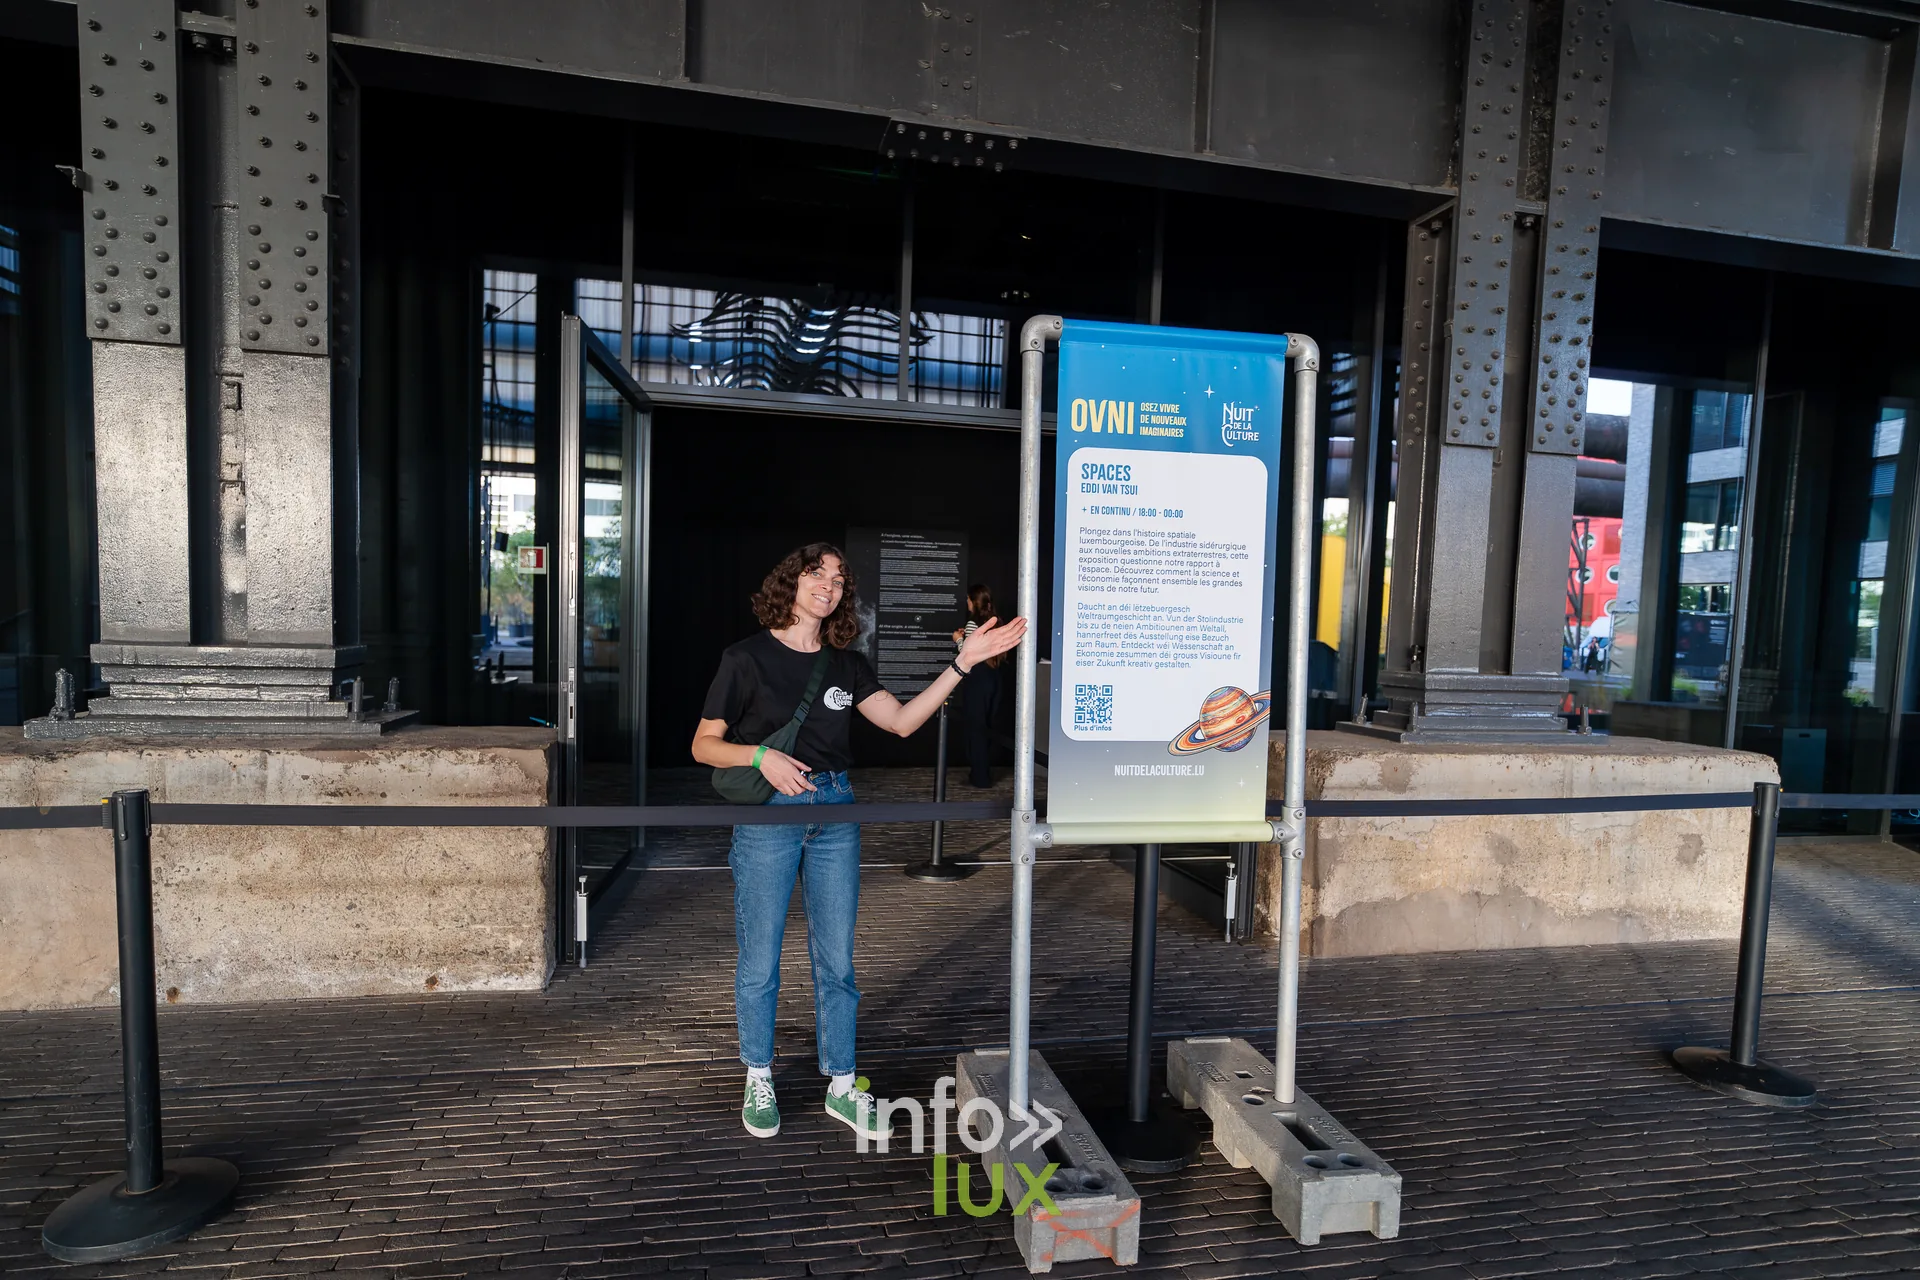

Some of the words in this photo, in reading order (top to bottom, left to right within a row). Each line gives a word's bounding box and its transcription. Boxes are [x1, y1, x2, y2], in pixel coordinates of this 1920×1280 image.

[1140, 402, 1158, 412] OSEZ
[1159, 403, 1180, 414] VIVRE
[1222, 401, 1254, 426] NUIT
[1070, 398, 1135, 435] OVNI
[1140, 414, 1150, 424] DE
[1150, 415, 1187, 426] NOUVEAUX
[1139, 426, 1184, 438] IMAGINAIRES
[1233, 422, 1242, 430] DE
[1221, 424, 1260, 447] CULTURE
[1081, 463, 1131, 482] SPACES
[1081, 483, 1100, 494] EDDI
[1101, 484, 1118, 495] VAN
[1120, 485, 1138, 496] TSUI
[1090, 506, 1100, 515] EN
[1101, 506, 1131, 516] CONTINU
[1138, 508, 1157, 517] 18:00
[1163, 509, 1184, 519] 00:00
[1079, 527, 1111, 537] Plongez
[1112, 528, 1132, 537] dans
[1133, 529, 1166, 538] l'histoire
[1167, 530, 1196, 540] spatiale
[1079, 537, 1147, 548] luxembourgeoise.
[1161, 540, 1198, 549] l'industrie
[1199, 541, 1247, 551] sidérurgique
[1095, 546, 1132, 556] nouvelles
[1133, 548, 1171, 557] ambitions
[1172, 550, 1229, 560] extraterrestres,
[1230, 552, 1249, 560] cette
[1078, 556, 1118, 565] exposition
[1120, 557, 1163, 567] questionne
[1164, 559, 1185, 567] notre
[1186, 560, 1214, 568] rapport
[1215, 559, 1220, 568] à
[1078, 565, 1112, 575] l'espace.
[1114, 565, 1154, 575] Découvrez
[1155, 568, 1191, 576] comment
[1193, 568, 1200, 577] la
[1201, 569, 1230, 578] science
[1232, 570, 1240, 578] et
[1078, 574, 1120, 583] l'économie
[1121, 575, 1160, 585] façonnent
[1161, 577, 1198, 586] ensemble
[1199, 578, 1211, 586] les
[1212, 579, 1243, 588] grandes
[1077, 583, 1105, 592] visions
[1106, 584, 1117, 593] de
[1140, 585, 1159, 594] futur.
[1077, 602, 1106, 611] Daucht
[1119, 603, 1132, 612] déi
[1077, 612, 1151, 622] Weltraumgeschicht
[1166, 615, 1181, 623] Vun
[1183, 615, 1195, 623] der
[1197, 615, 1244, 624] Stolindustrie
[1076, 621, 1089, 630] bis
[1101, 622, 1111, 630] de
[1113, 623, 1134, 631] neien
[1135, 623, 1185, 632] Ambitiounen
[1076, 631, 1122, 640] hannerfreet
[1139, 632, 1183, 642] Ausstellung
[1121, 641, 1154, 649] Entdeckt
[1156, 642, 1170, 650] wéi
[1076, 650, 1115, 658] Ekonomie
[1116, 651, 1158, 659] zesummen
[1159, 651, 1171, 659] déi
[1173, 652, 1198, 661] grouss
[1199, 652, 1232, 660] Visioune
[1233, 652, 1241, 660] fir
[1096, 659, 1126, 667] Zukunft
[1127, 660, 1153, 668] kreativ
[1074, 724, 1088, 732] Plus
[1089, 724, 1112, 732] d'infos
[1114, 764, 1205, 776] NUITDELACULTURE.LU
